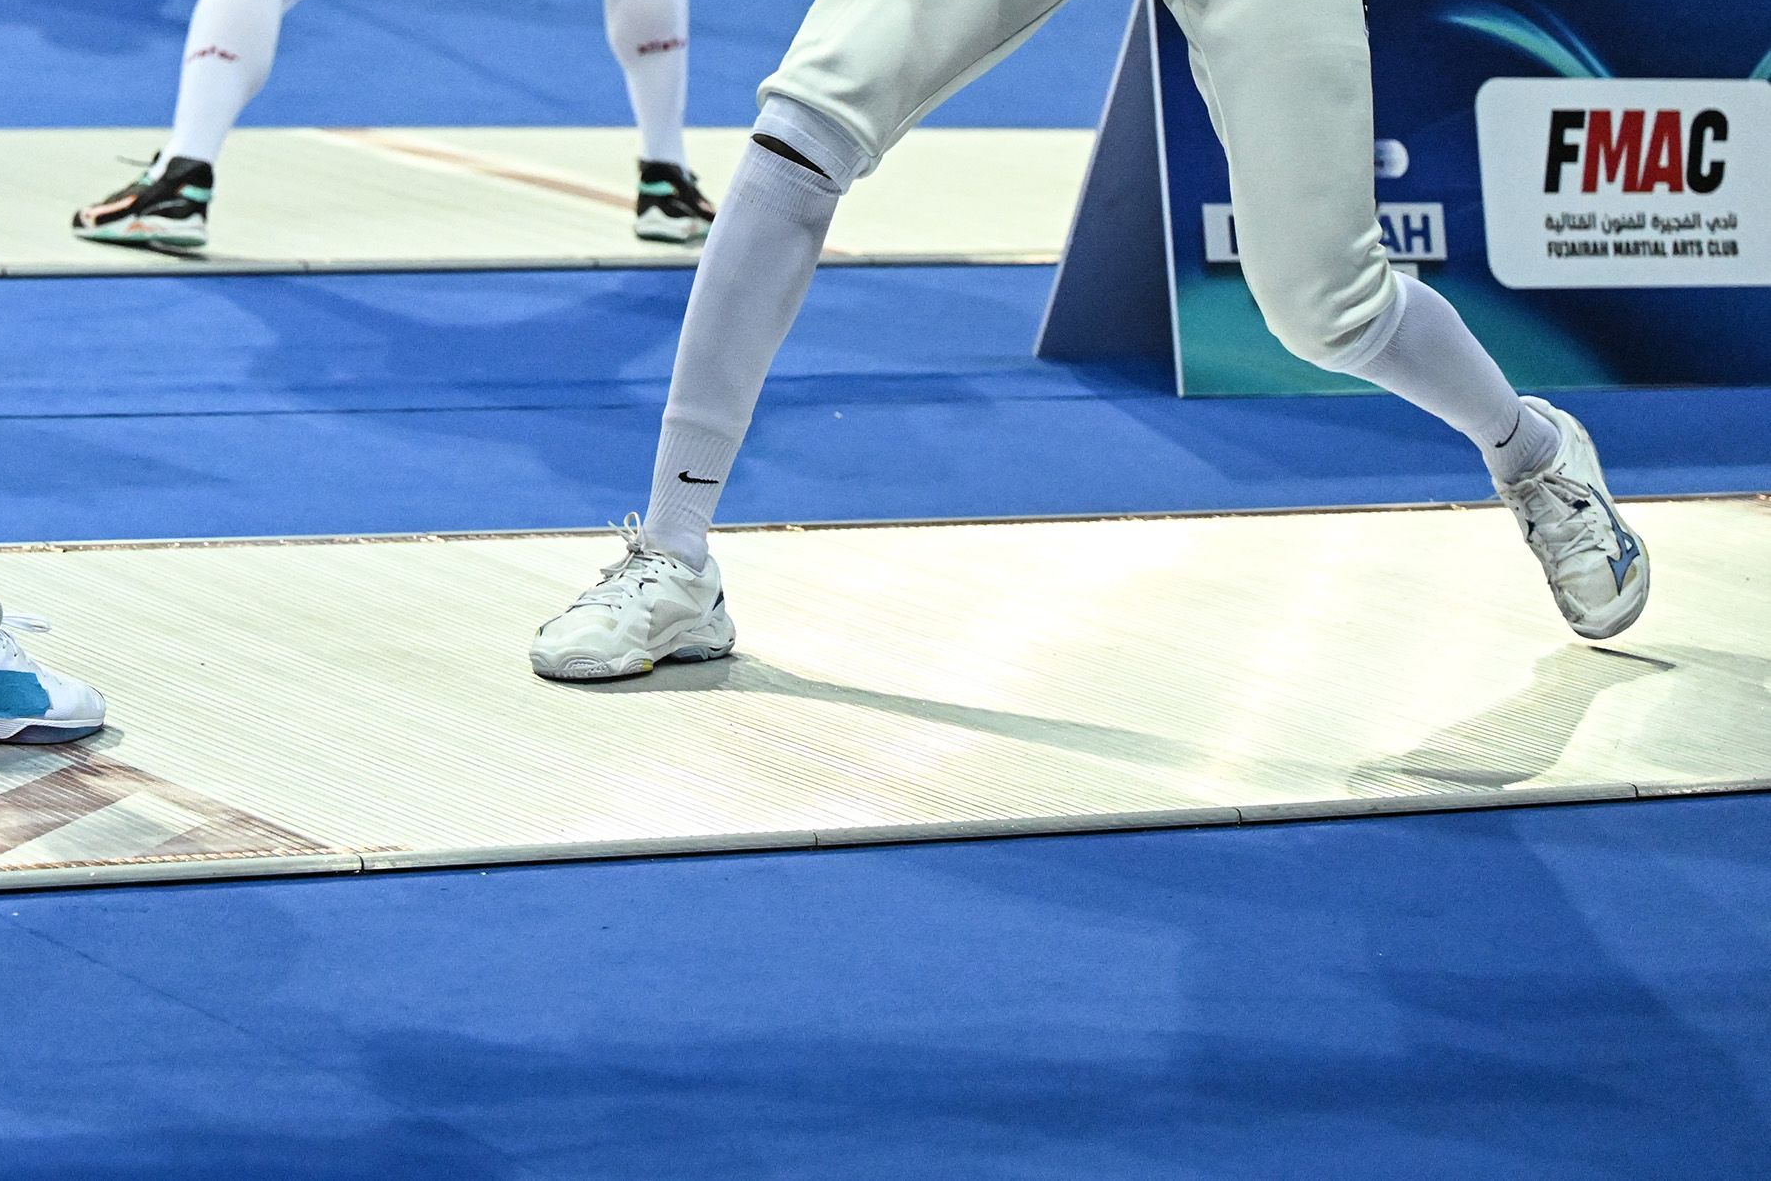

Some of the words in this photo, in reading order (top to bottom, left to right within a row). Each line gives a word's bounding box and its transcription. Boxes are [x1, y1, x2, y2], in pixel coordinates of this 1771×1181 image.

[1543, 108, 1730, 194] FMAC
[1544, 213, 1596, 234] القتالية
[1601, 213, 1646, 235] للفنون
[1651, 213, 1702, 234] الفجيرة
[1706, 213, 1738, 233] نادي
[1547, 240, 1610, 257] FUJAIRAH
[1613, 240, 1668, 257] MARTIAL
[1671, 240, 1704, 257] ARTS
[1706, 240, 1740, 257] CLUB
